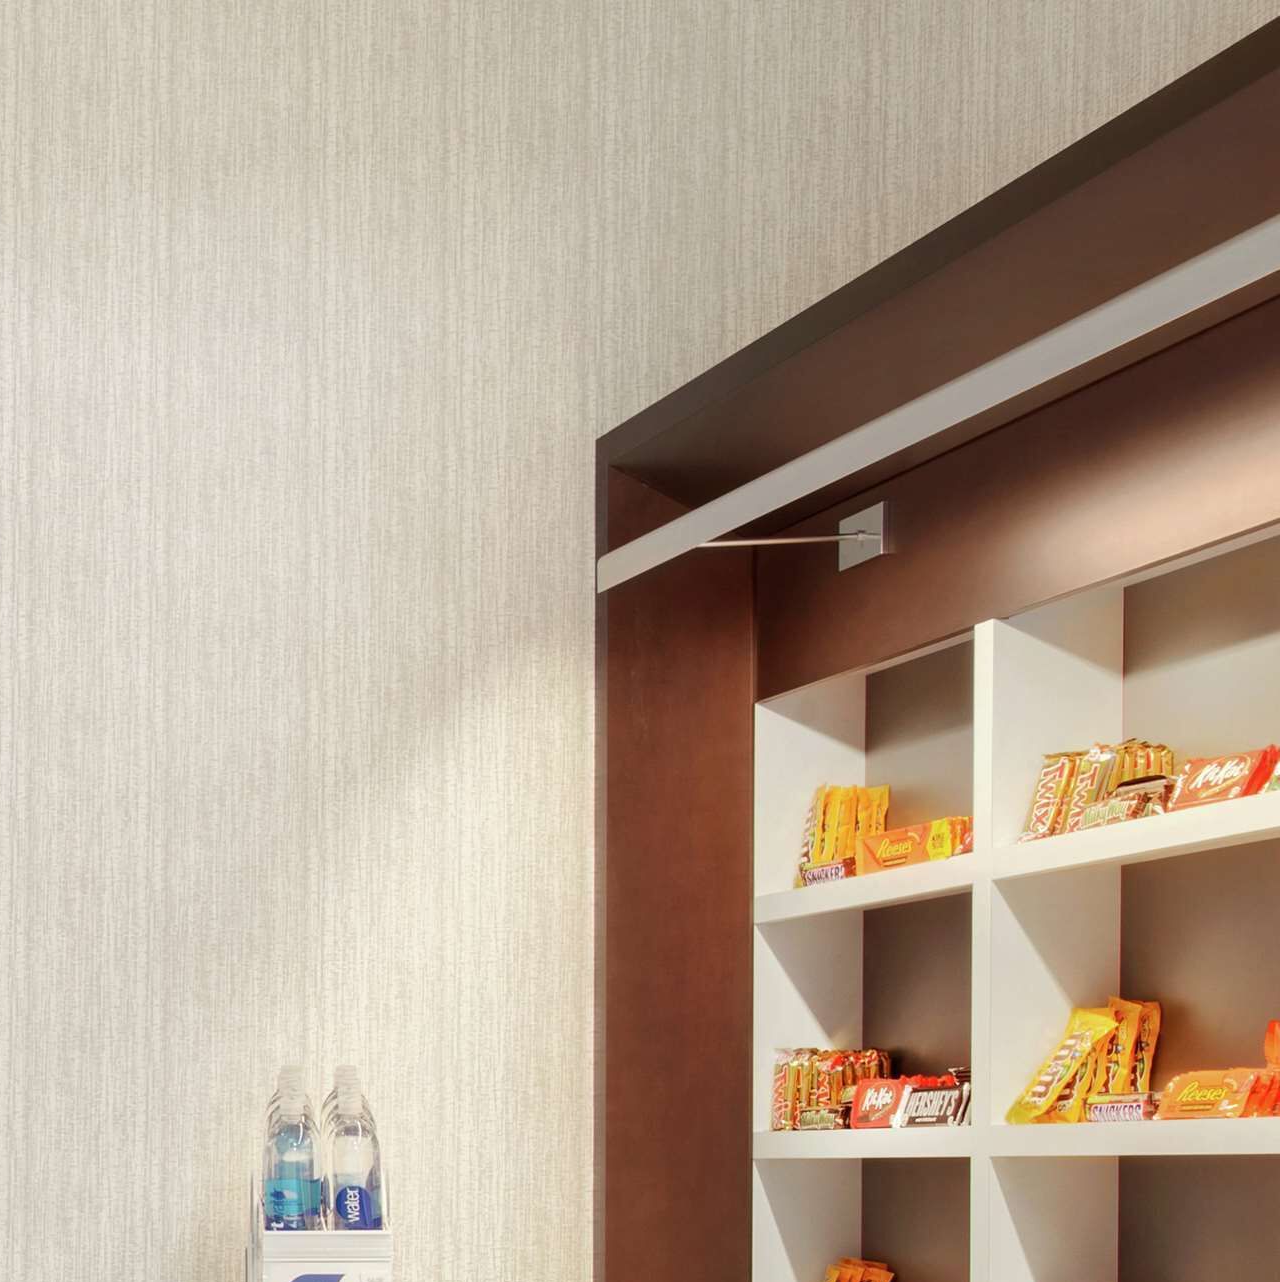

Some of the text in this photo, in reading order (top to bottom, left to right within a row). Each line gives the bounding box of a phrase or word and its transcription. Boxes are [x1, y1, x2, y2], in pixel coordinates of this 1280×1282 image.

[907, 1089, 958, 1117] HERSHEY'S
[1091, 1104, 1142, 1122] SNICKERS
[346, 1187, 360, 1224] water
